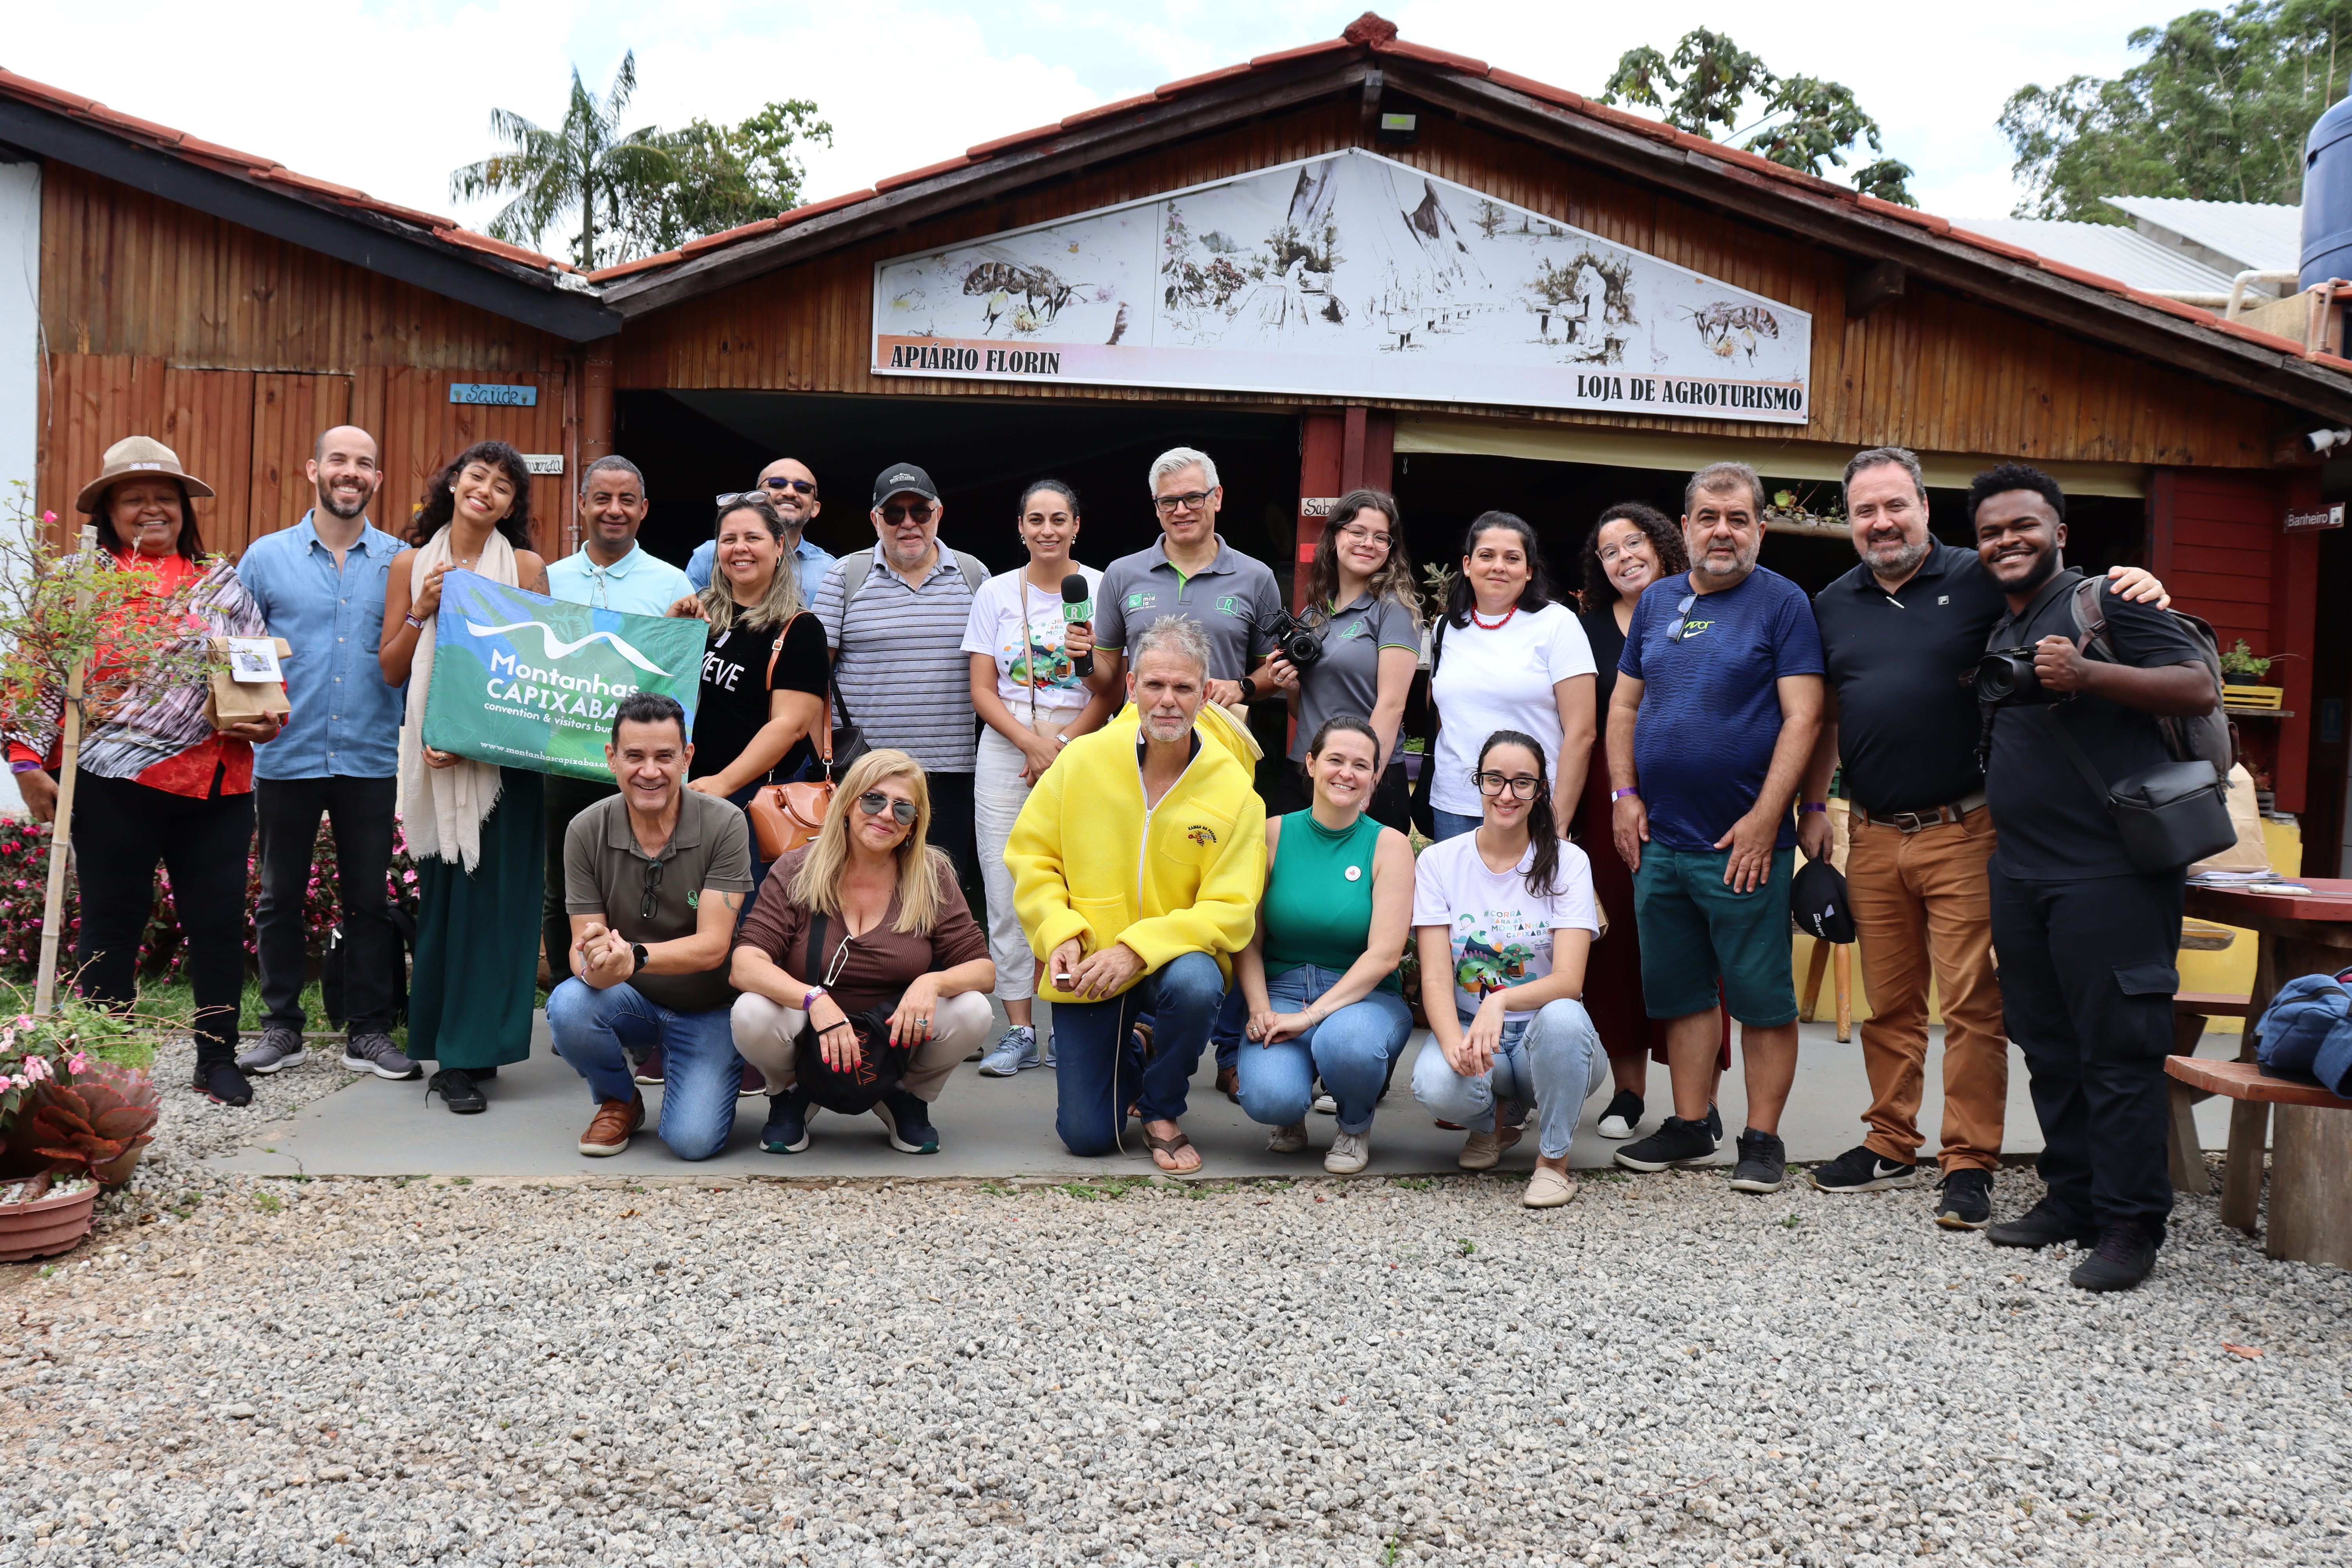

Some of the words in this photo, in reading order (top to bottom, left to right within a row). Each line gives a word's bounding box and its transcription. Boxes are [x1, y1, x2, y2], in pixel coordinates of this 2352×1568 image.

[890, 342, 978, 370] APIÁRIO
[985, 349, 1061, 374] FLORIN
[1577, 375, 1623, 401] LOJA
[1630, 378, 1655, 401] DE
[1662, 380, 1802, 411] AGROTURISMO
[526, 460, 562, 472] nversa
[2288, 511, 2328, 527] Banheiro
[1071, 606, 1078, 619] R
[490, 648, 640, 698] Montanhas
[486, 678, 619, 720] CAPIXABA
[484, 702, 539, 721] convention
[543, 713, 551, 723] &
[554, 715, 591, 730] visitors
[594, 721, 613, 733] bur
[480, 742, 611, 771] www.montanhascapixabas.or
[1492, 920, 1550, 932] MONTANHAS
[1506, 929, 1552, 938] CAPIXABAS
